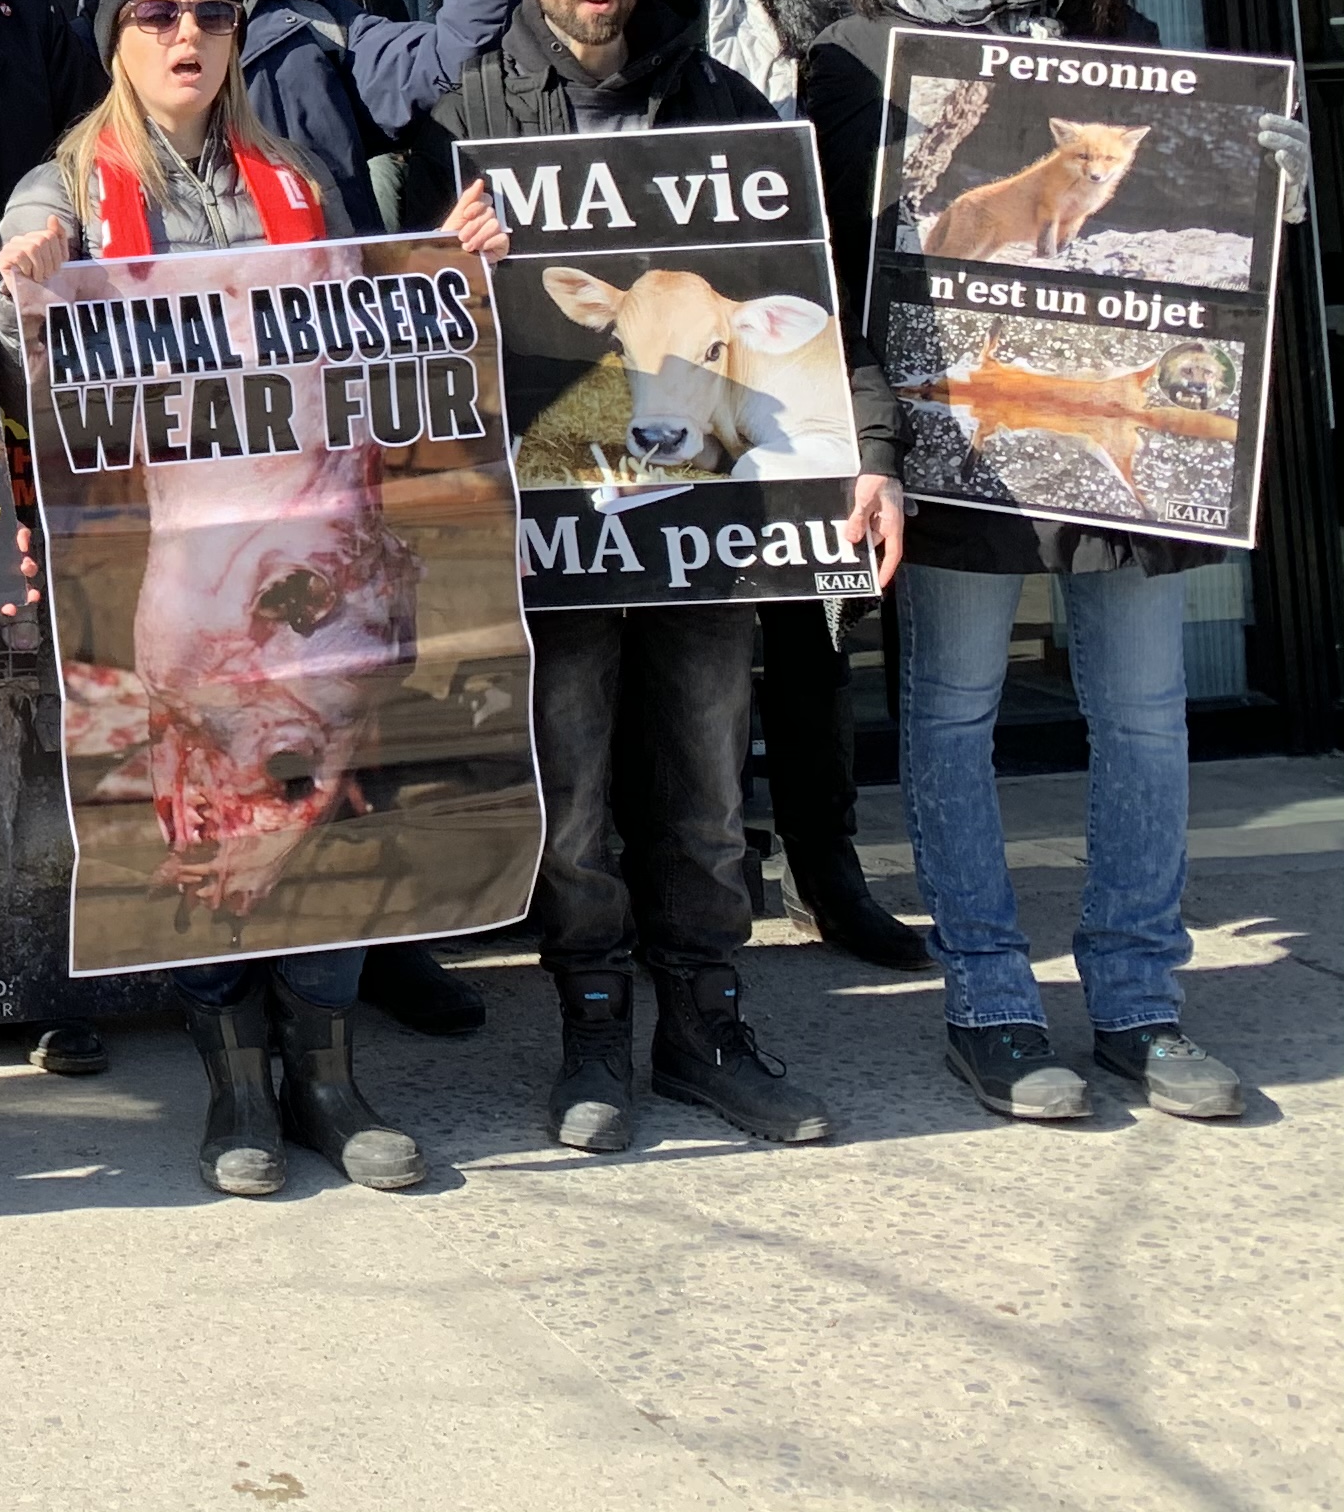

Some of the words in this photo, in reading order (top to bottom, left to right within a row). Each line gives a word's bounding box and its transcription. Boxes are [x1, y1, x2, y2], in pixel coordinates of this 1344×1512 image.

[979, 44, 1198, 94] Personne
[487, 161, 636, 234] MA
[653, 154, 790, 225] vie
[46, 291, 244, 387] ANIMAL
[249, 267, 477, 368] ABUSERS
[930, 272, 1026, 309] n'est
[1035, 287, 1087, 317] un
[1097, 289, 1208, 332] objet
[51, 371, 303, 474] WEAR
[321, 355, 486, 452] FUR
[1169, 504, 1225, 525] KARA
[520, 516, 645, 577] MA
[661, 518, 859, 589] peau
[818, 573, 869, 592] KARA
